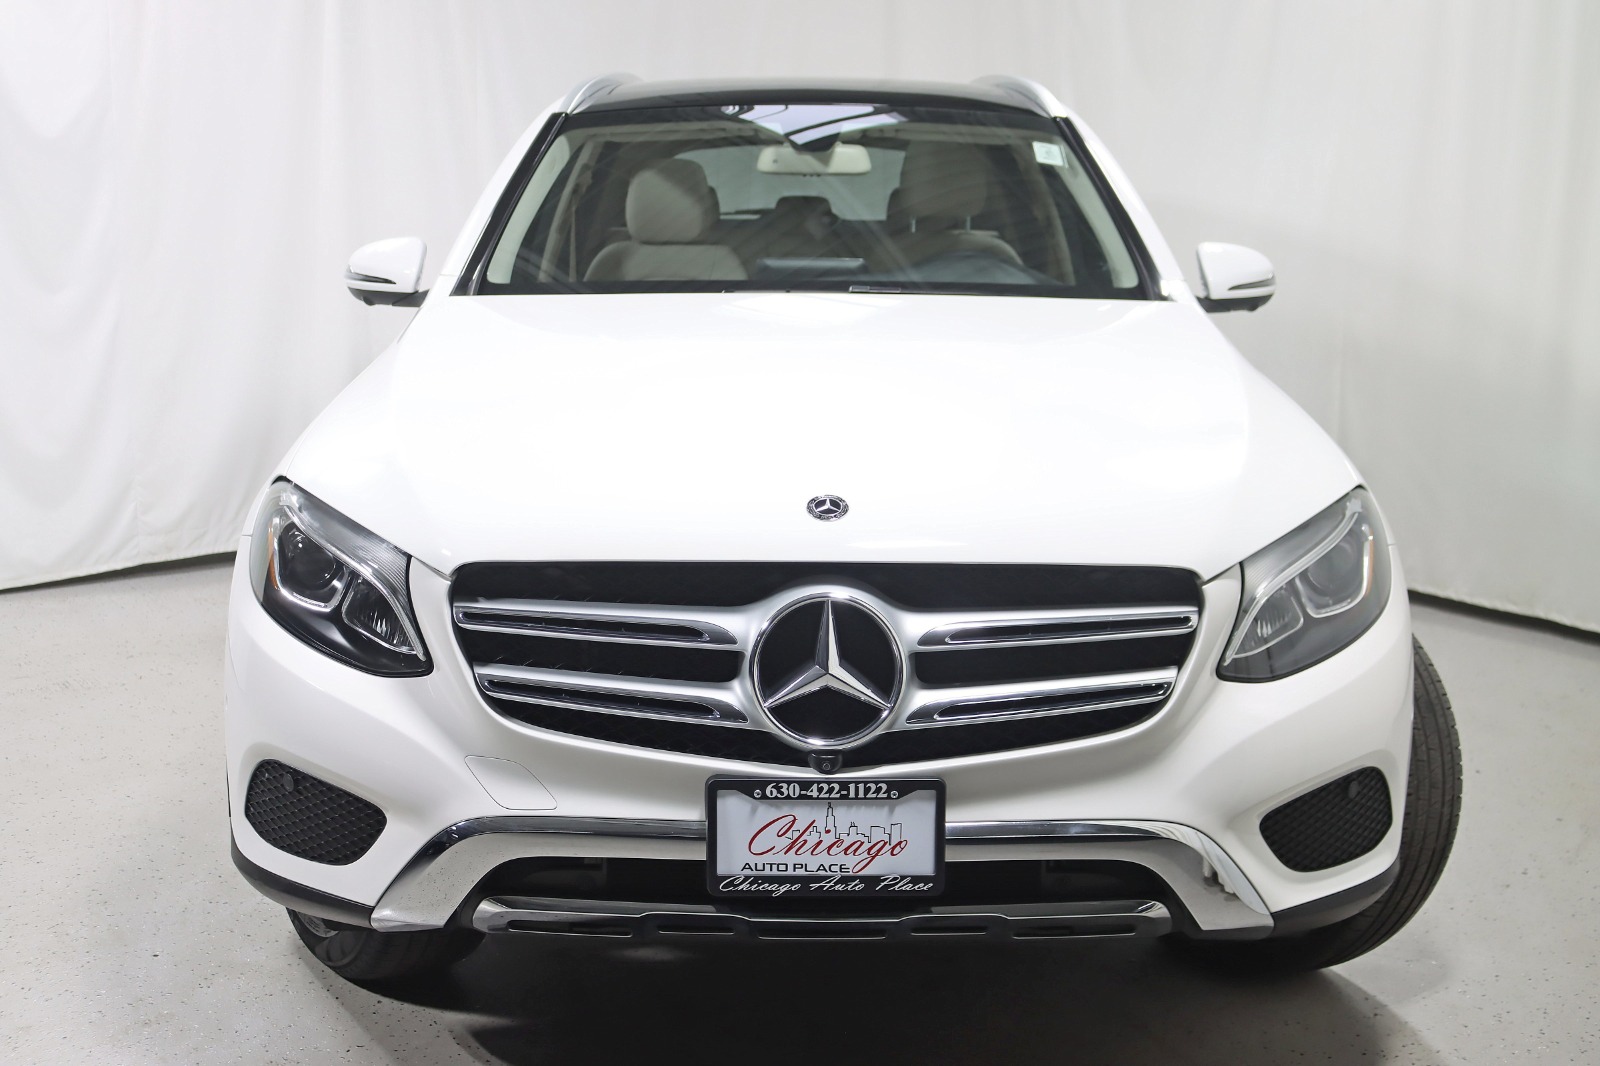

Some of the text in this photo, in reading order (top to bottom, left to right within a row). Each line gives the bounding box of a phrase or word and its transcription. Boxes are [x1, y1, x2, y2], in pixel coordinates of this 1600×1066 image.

[765, 782, 888, 799] 630-422-1122
[748, 814, 908, 874] Chicago
[741, 862, 850, 873] AUTO PLACE
[719, 874, 934, 897] Chicago Auto Place
